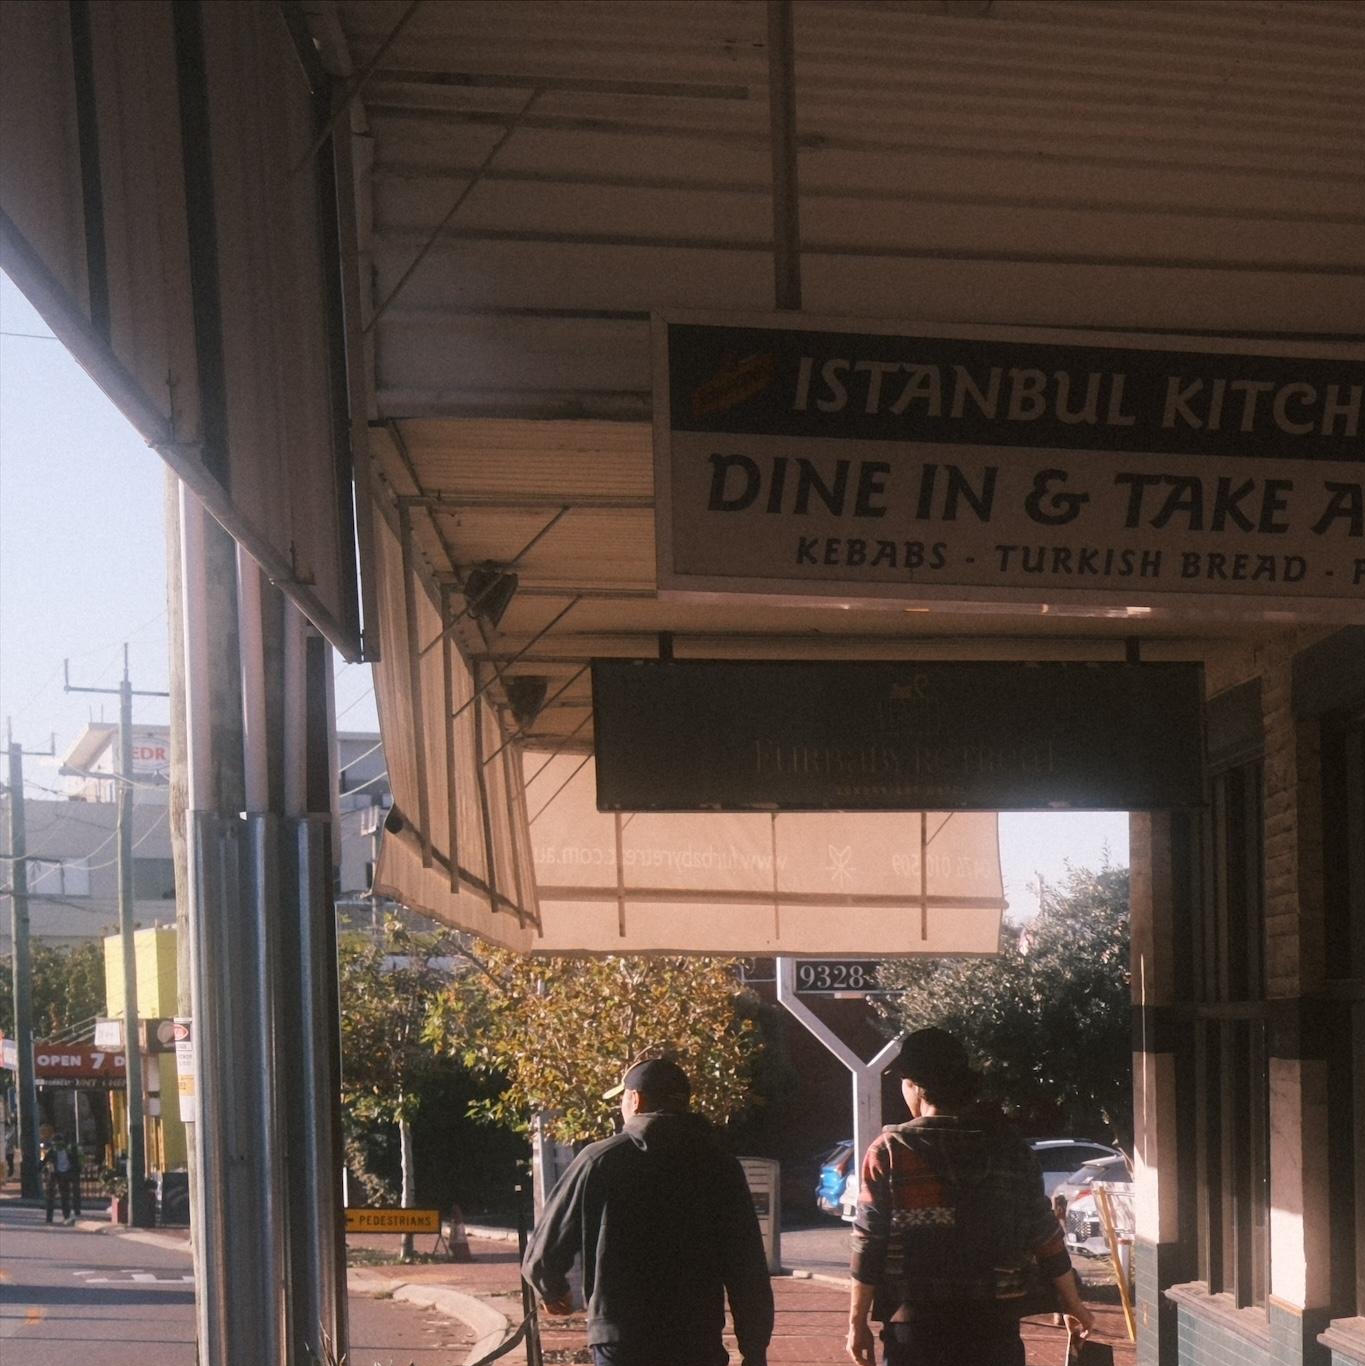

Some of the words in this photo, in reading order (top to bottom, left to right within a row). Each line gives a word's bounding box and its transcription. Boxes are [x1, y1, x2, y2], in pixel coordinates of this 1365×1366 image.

[795, 354, 1137, 428] ISTANBUL
[706, 450, 892, 522] DINE
[916, 462, 999, 524] IN
[1024, 466, 1091, 529] &
[1112, 470, 1298, 536] TAKE
[796, 535, 950, 572] KEBABS
[994, 543, 1164, 580] TURKISH
[1180, 550, 1310, 586] BREAD
[37, 1054, 82, 1067] OPEN
[90, 1053, 105, 1069] 7
[359, 1215, 432, 1227] PEDESTRIANS
